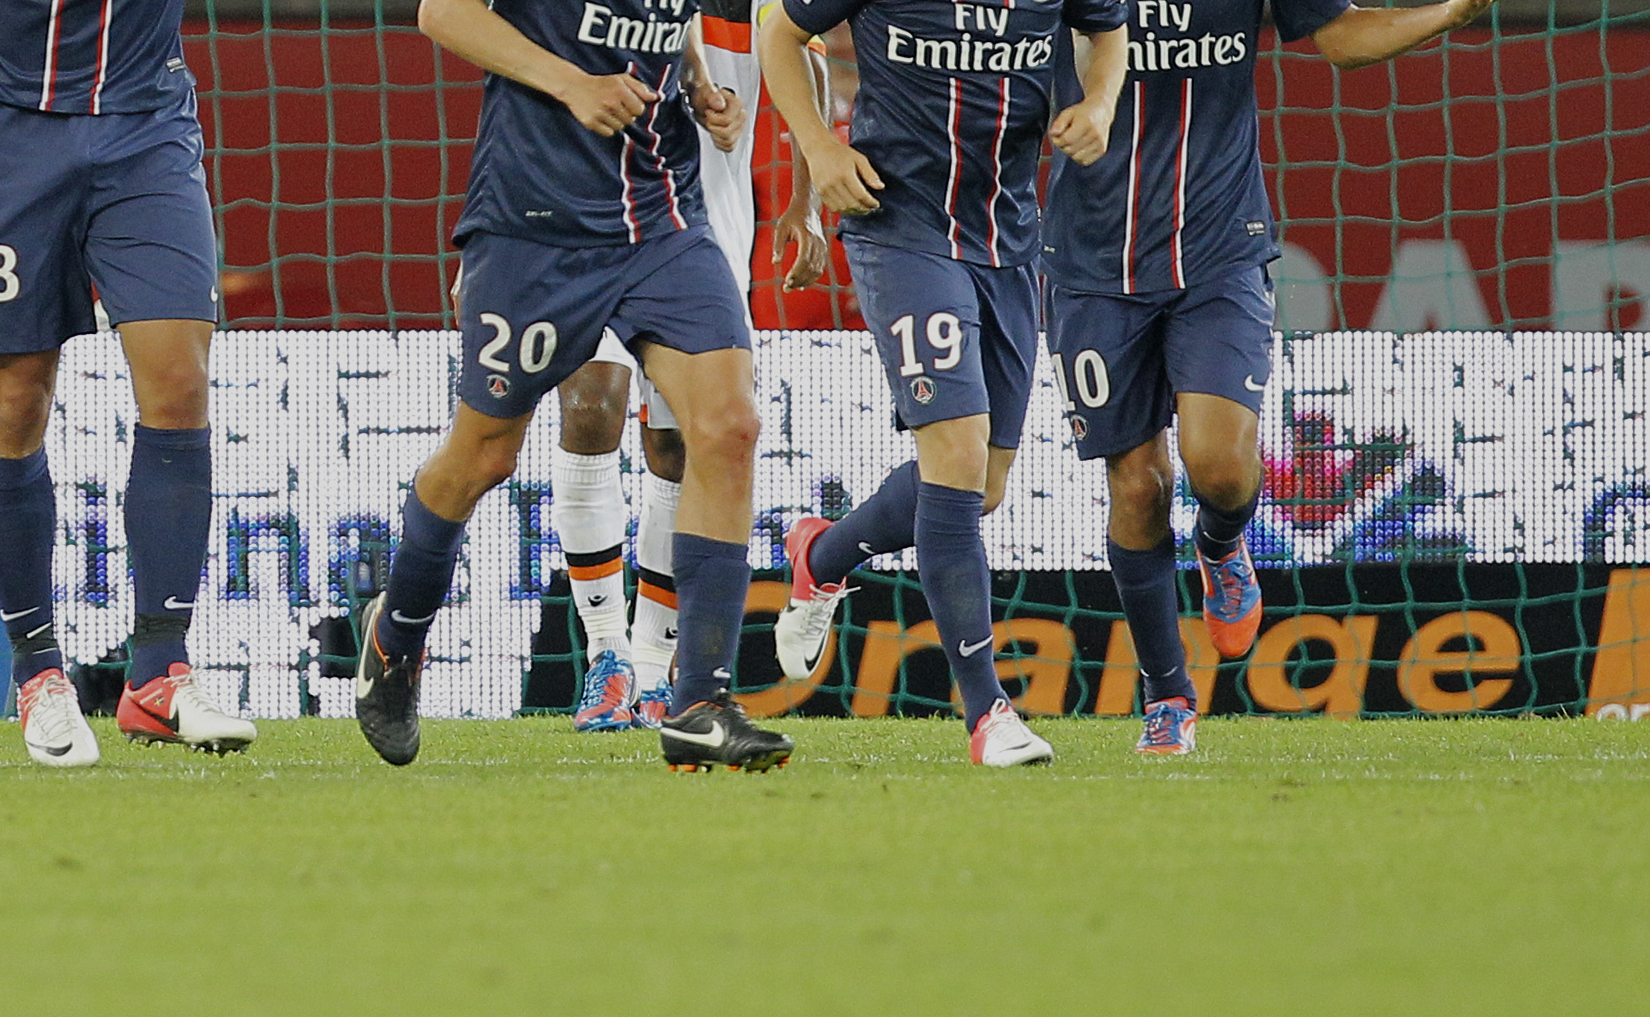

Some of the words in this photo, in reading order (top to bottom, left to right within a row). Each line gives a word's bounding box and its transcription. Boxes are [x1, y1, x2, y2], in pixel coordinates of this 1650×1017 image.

[954, 3, 1009, 36] Fly
[1137, 0, 1192, 32] Fly
[886, 25, 1053, 71] Emirates
[477, 313, 558, 373] 20
[890, 312, 963, 377] 19
